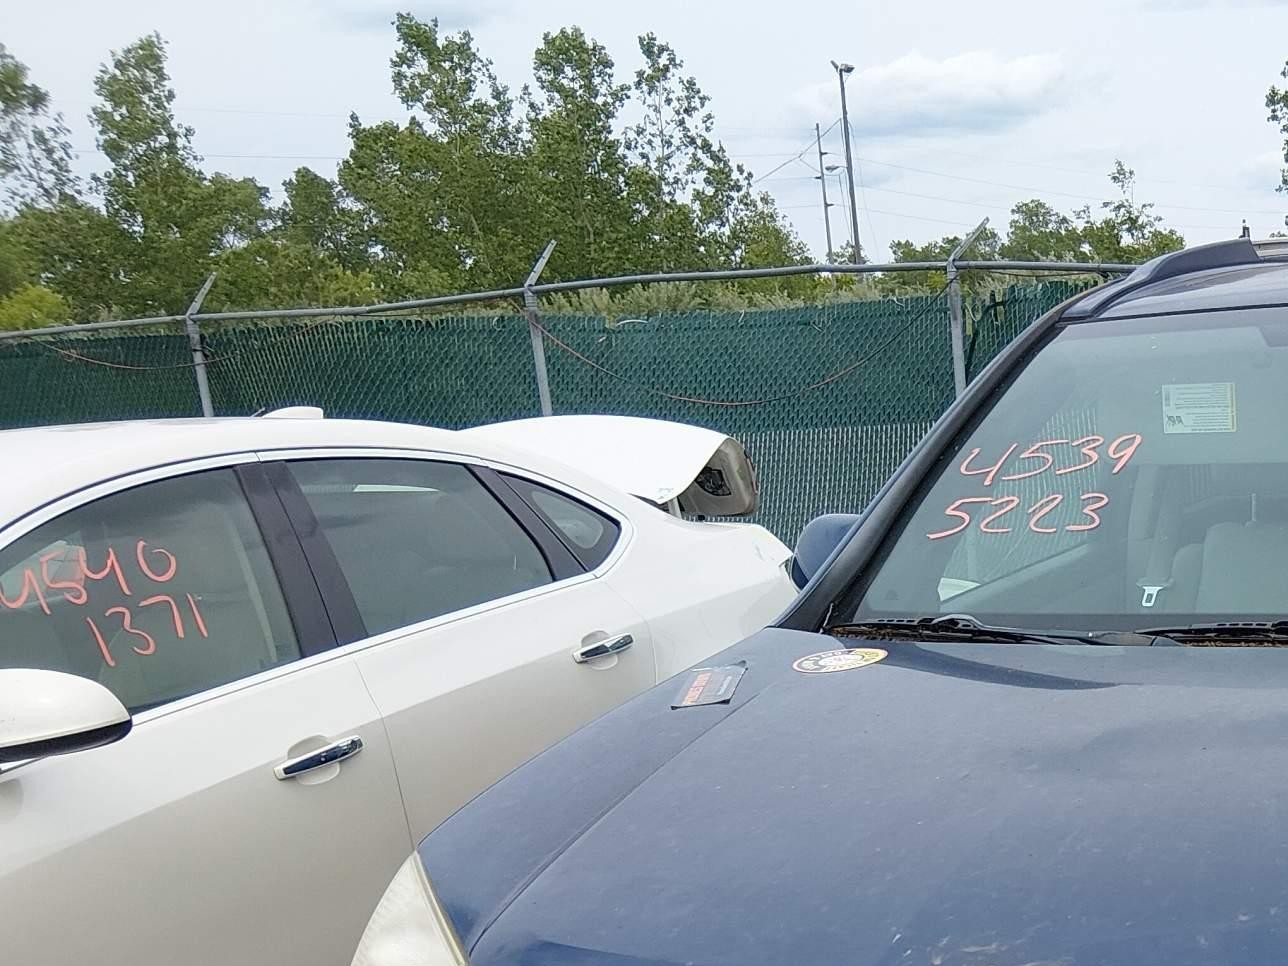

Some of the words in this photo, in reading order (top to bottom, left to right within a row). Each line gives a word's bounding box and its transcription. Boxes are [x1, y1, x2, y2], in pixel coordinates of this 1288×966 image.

[960, 433, 1142, 486] 4539
[926, 492, 1109, 540] 5223
[0, 538, 177, 616] 4540
[86, 592, 209, 668] 1371
